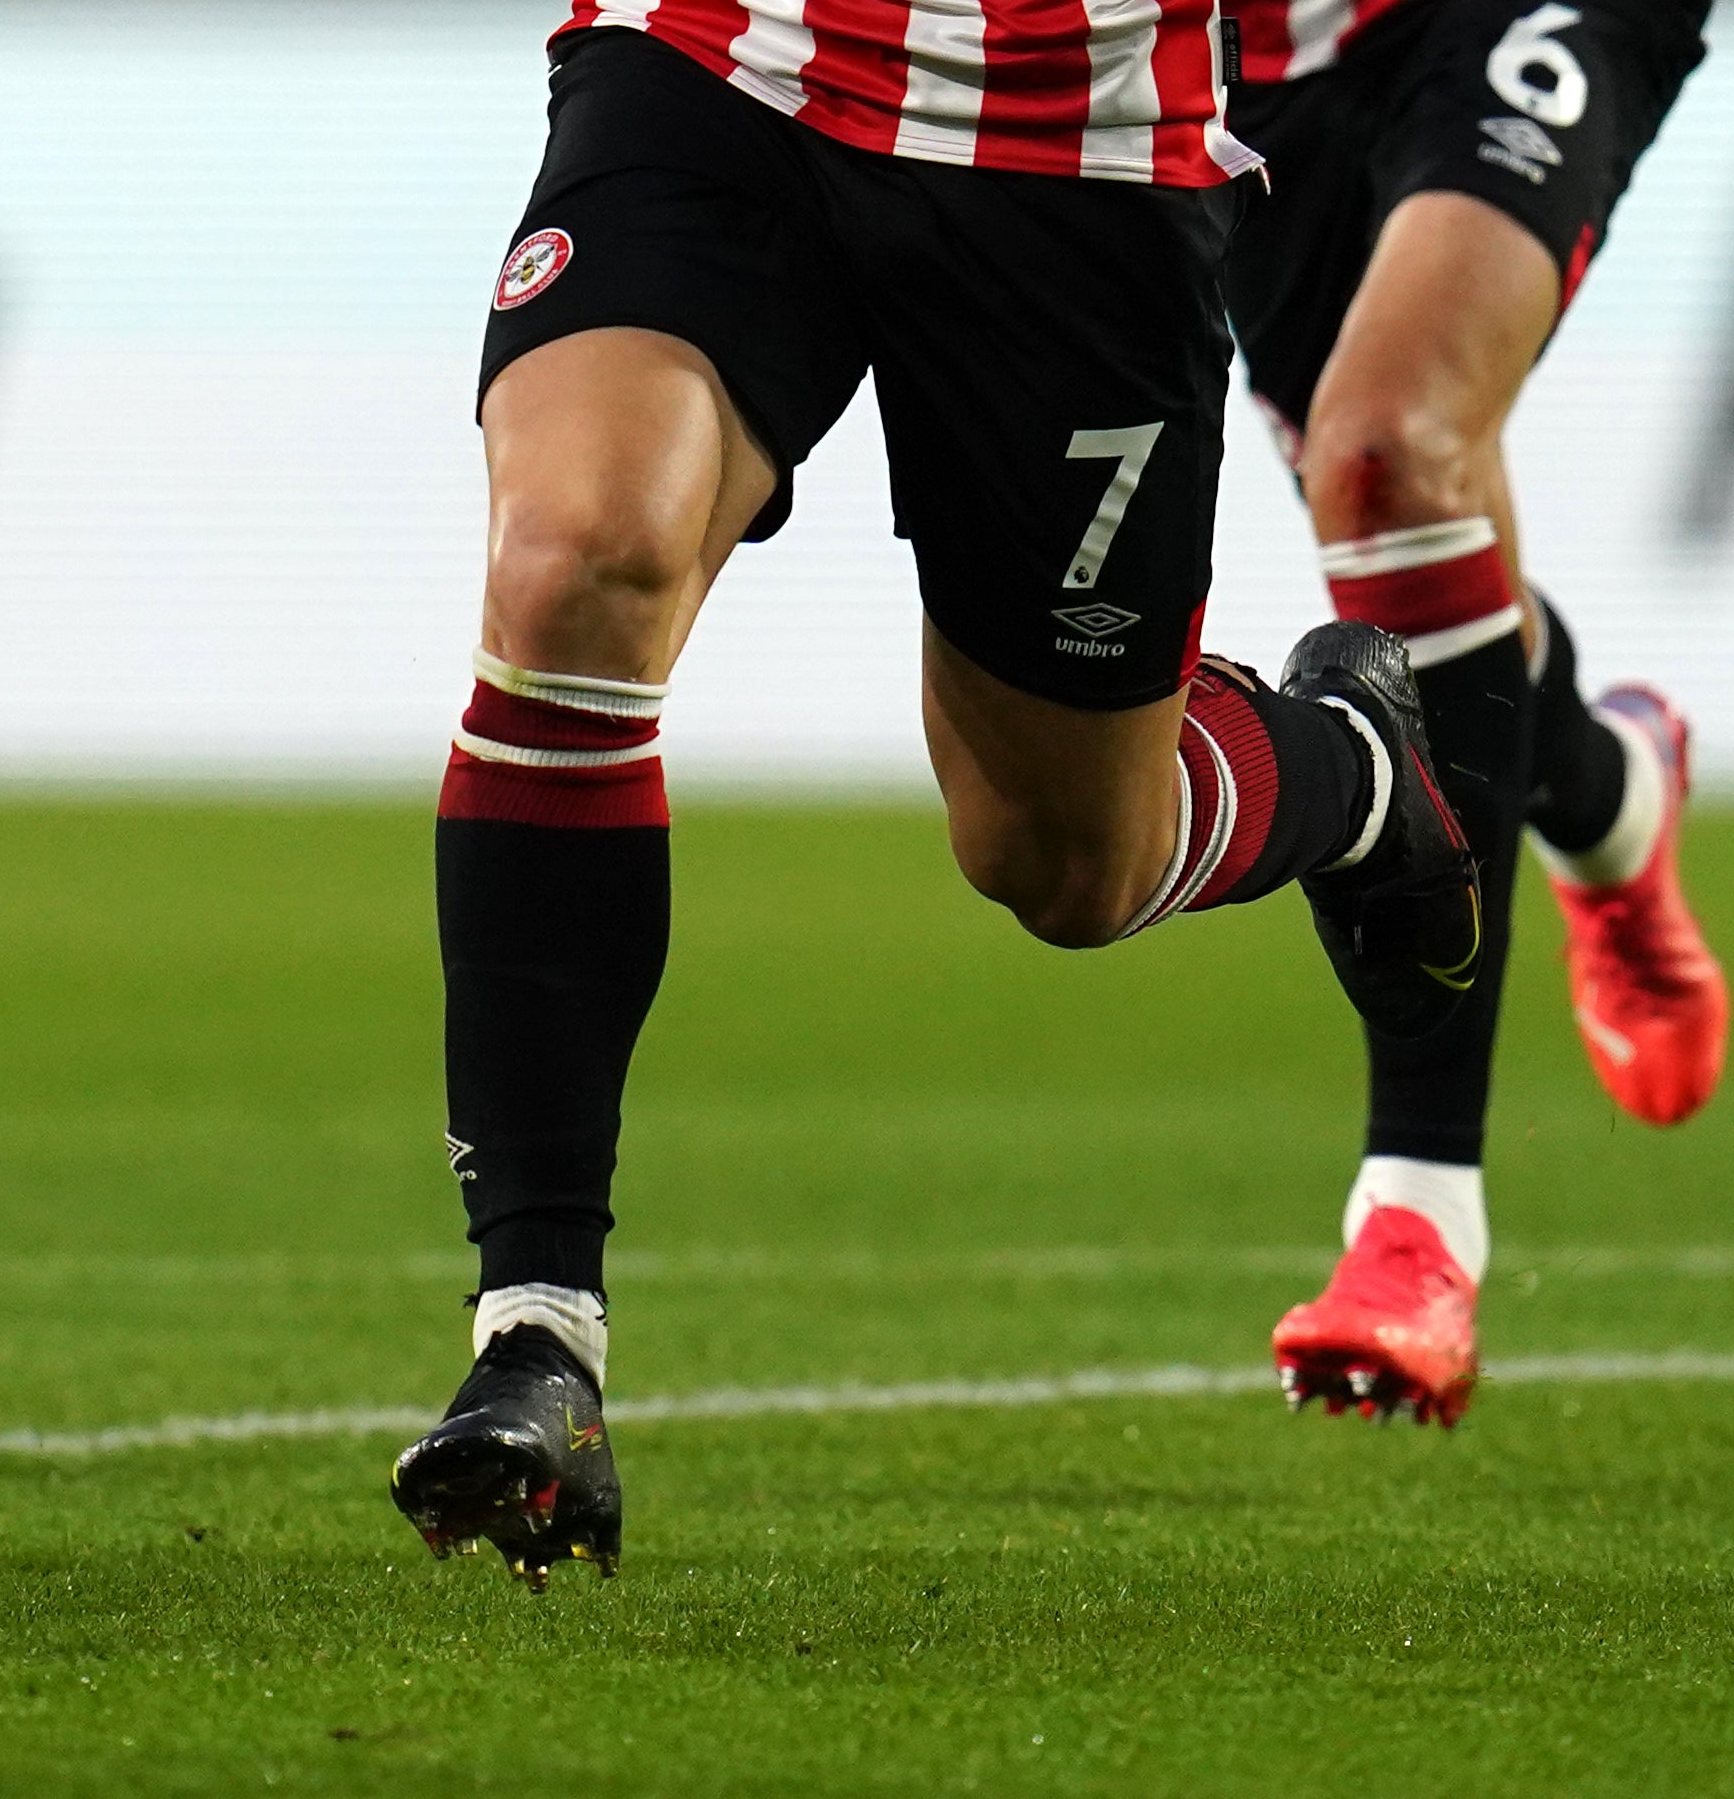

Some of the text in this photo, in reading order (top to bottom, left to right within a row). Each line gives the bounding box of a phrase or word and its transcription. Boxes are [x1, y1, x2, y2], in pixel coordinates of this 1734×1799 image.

[1485, 1, 1589, 128] 6
[1062, 420, 1165, 590] 7
[1054, 636, 1126, 659] umbro
